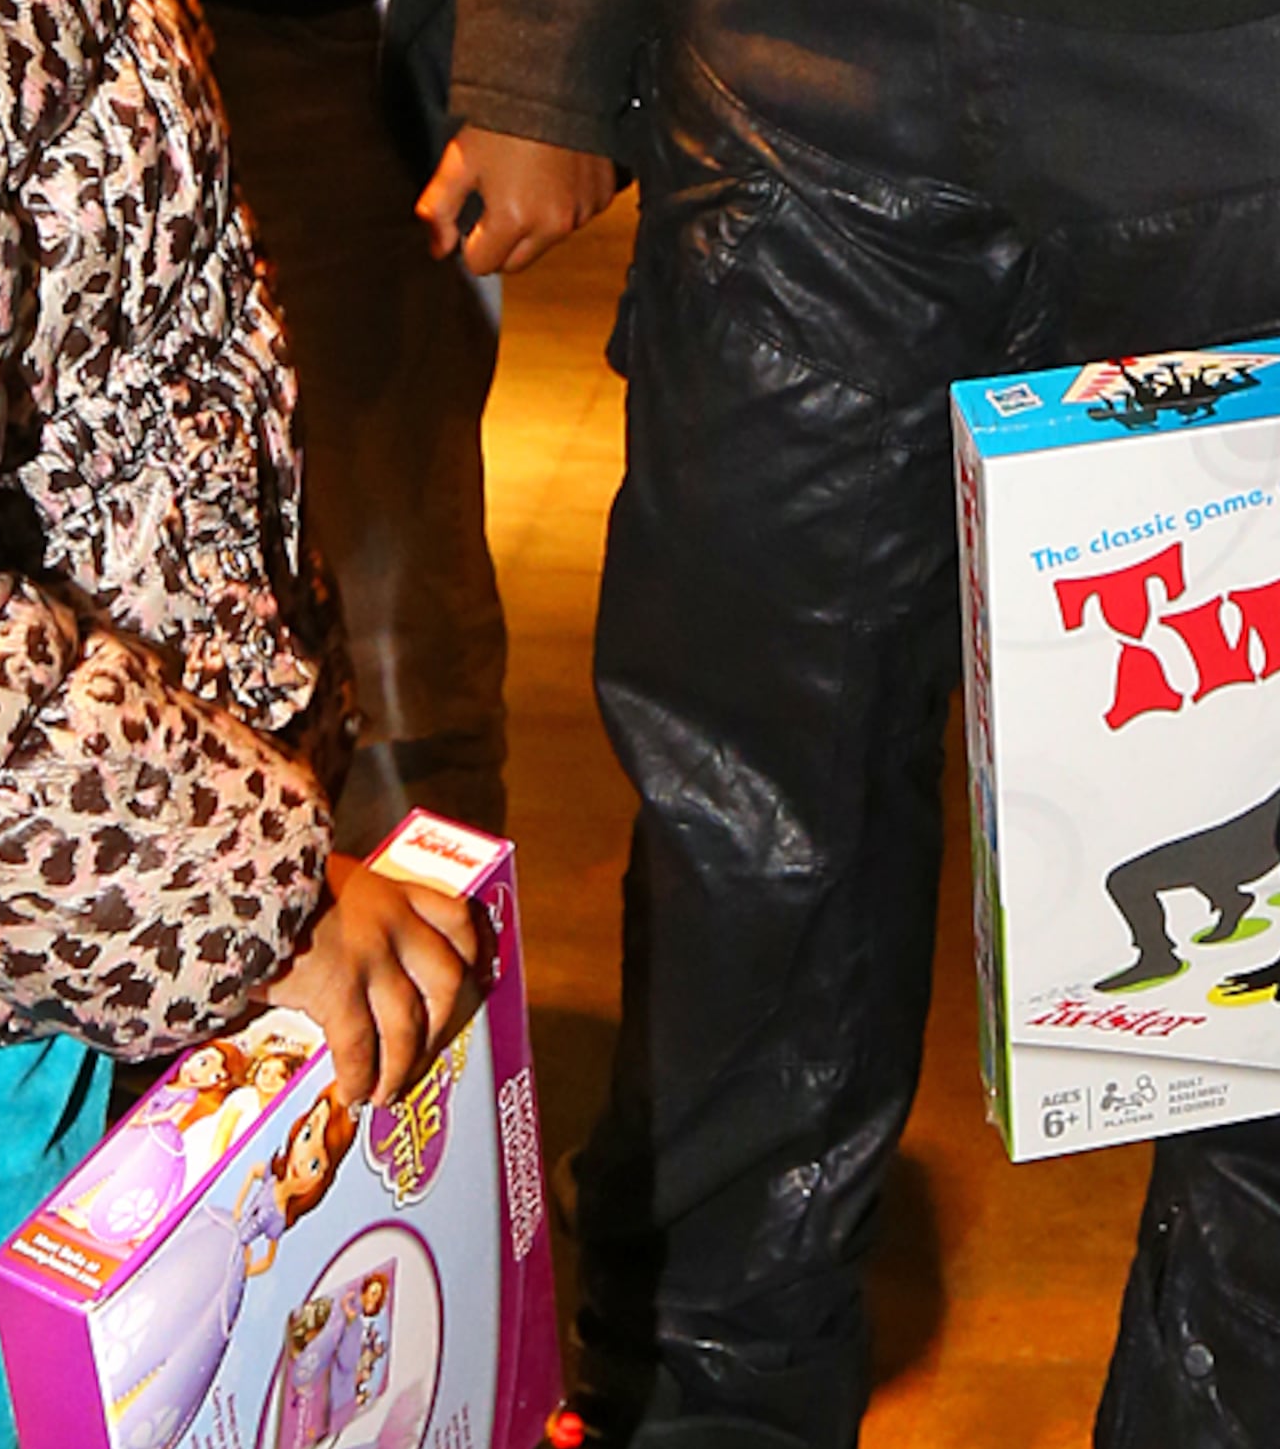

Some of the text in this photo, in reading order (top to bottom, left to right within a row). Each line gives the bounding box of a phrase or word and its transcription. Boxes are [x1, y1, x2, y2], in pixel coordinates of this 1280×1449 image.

[1031, 489, 1273, 573] The classic game,
[1041, 1088, 1081, 1108] AGES
[1043, 1109, 1079, 1138] 6+
